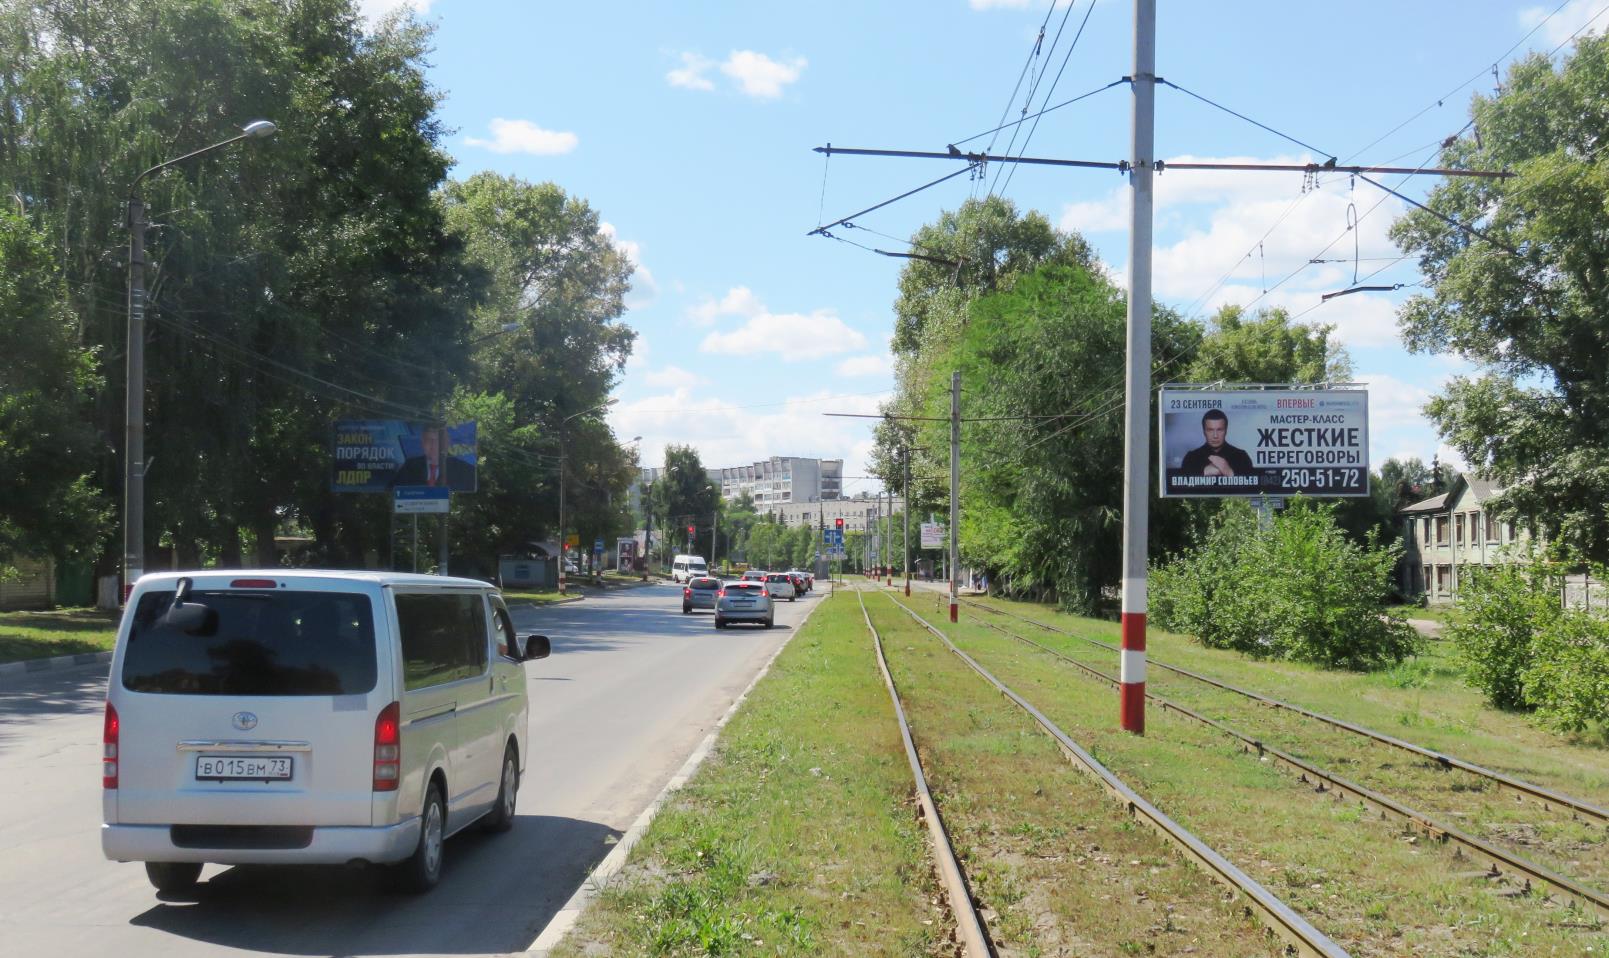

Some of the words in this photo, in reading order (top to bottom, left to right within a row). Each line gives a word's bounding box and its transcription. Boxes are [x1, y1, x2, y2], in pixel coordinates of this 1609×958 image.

[1170, 399, 1181, 409] 23
[1182, 399, 1222, 409] СЕНТЯБРЯ
[1276, 398, 1315, 409] ВПЕРВЫЕ
[1270, 414, 1345, 424] МАСТЕР-КЛАСС
[1257, 428, 1359, 447] ЖЕСТКИЕ
[336, 447, 395, 461] ПОРЯДОК
[1257, 450, 1359, 464] ПЕРЕГОВОРЫ
[336, 471, 371, 485] ЛДПР
[1171, 475, 1217, 487] ВЛАДИМИР
[1217, 475, 1259, 487] СОЛОВЬЕВ
[1281, 469, 1359, 487] 250-51-72
